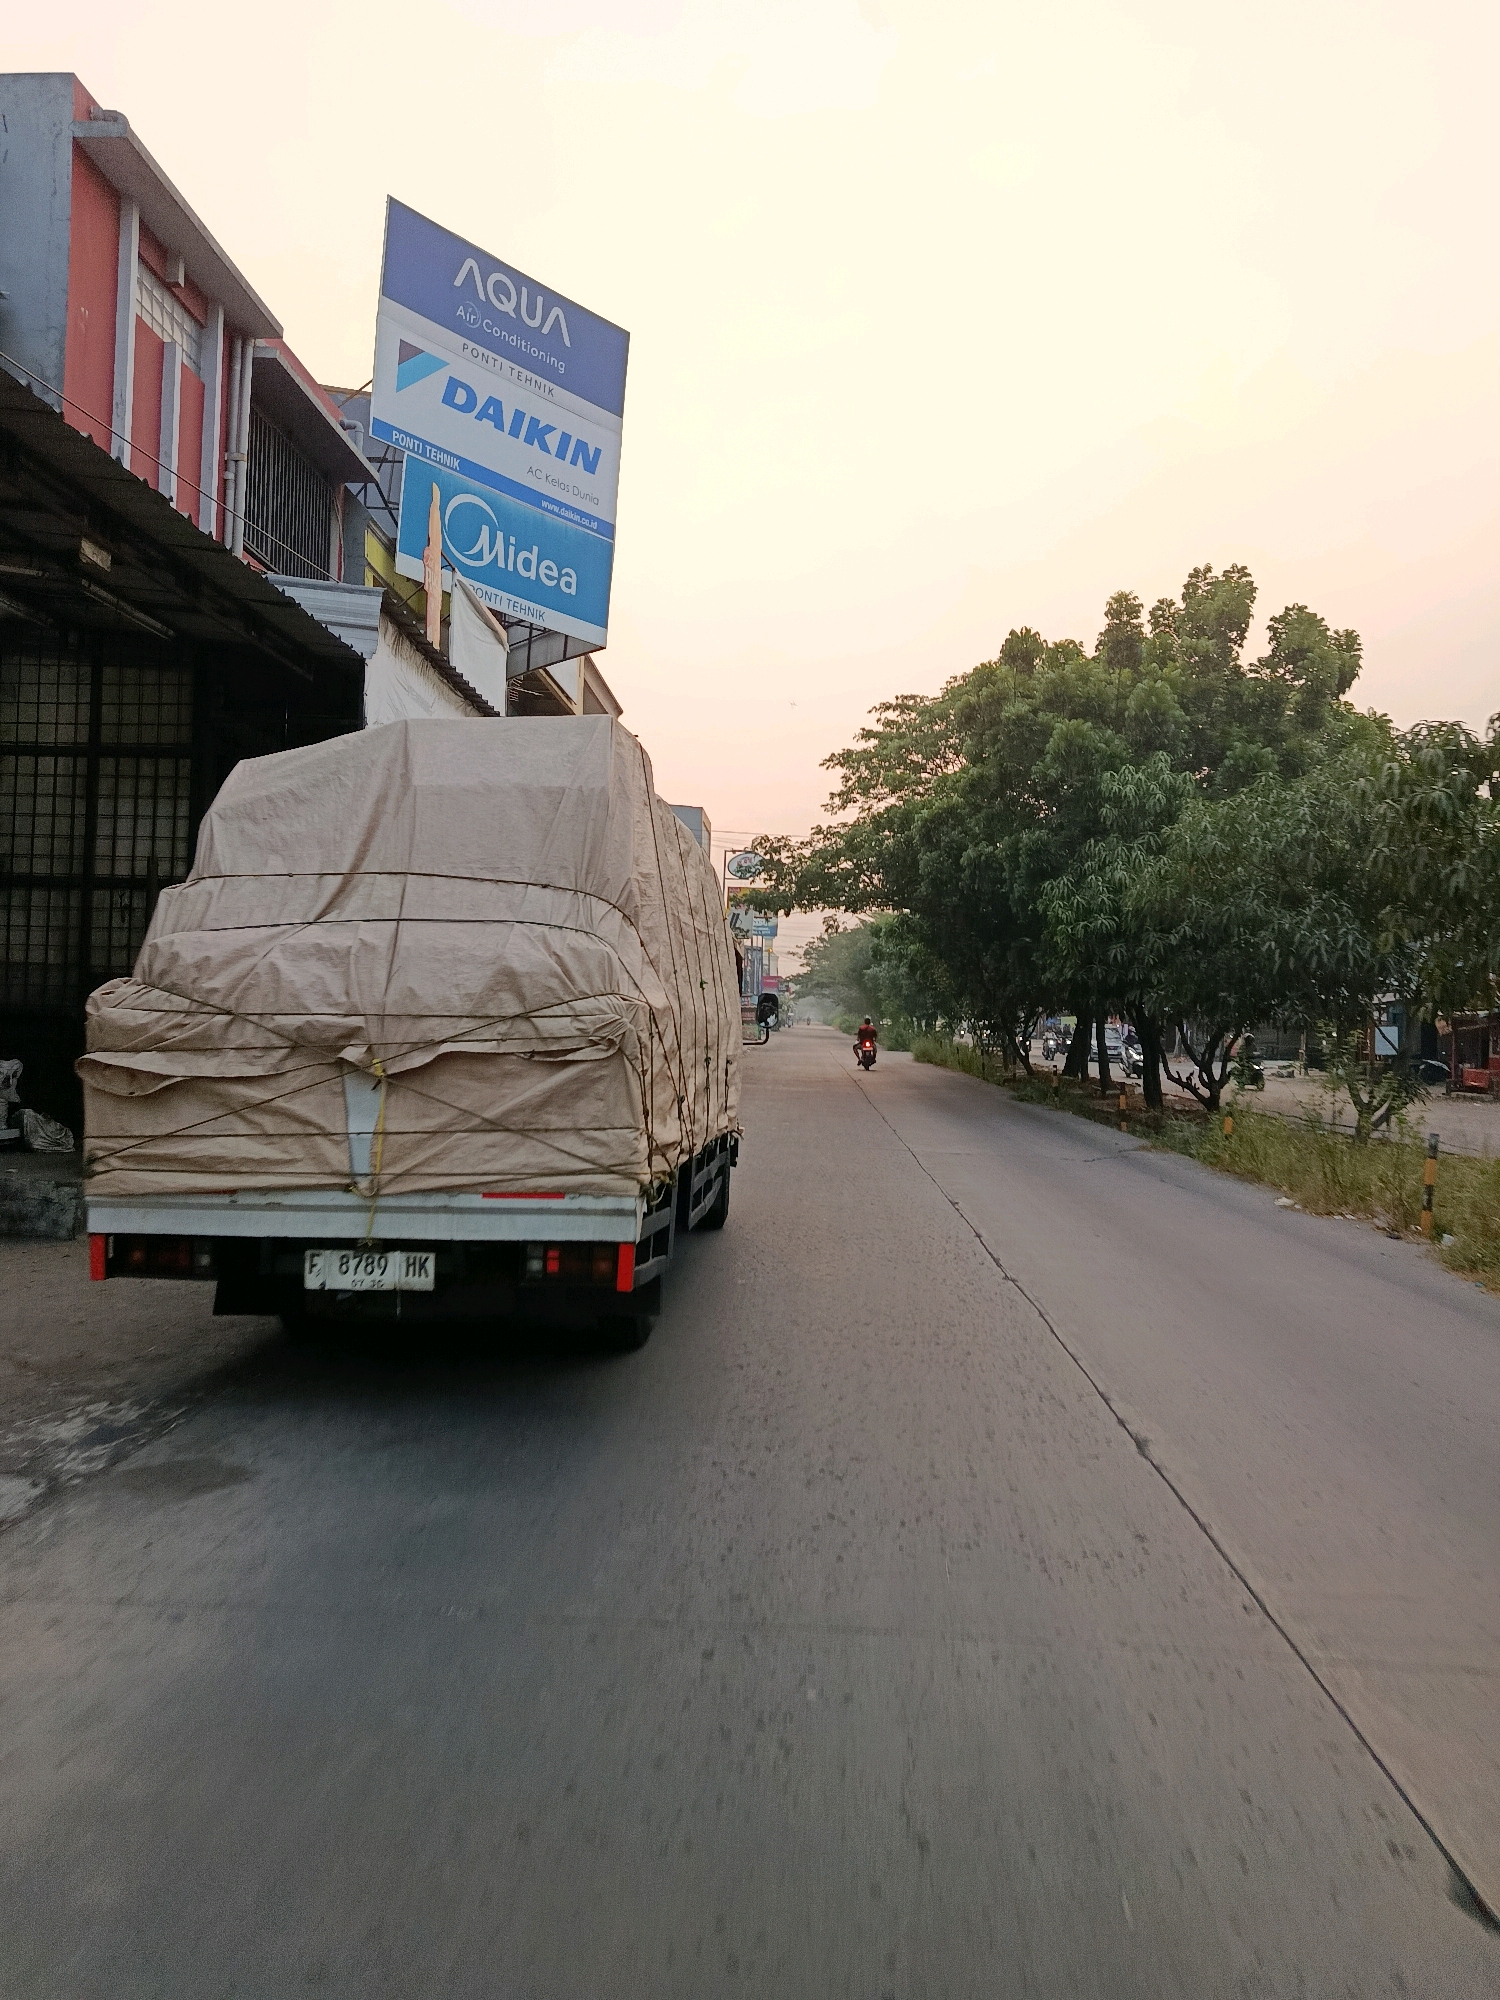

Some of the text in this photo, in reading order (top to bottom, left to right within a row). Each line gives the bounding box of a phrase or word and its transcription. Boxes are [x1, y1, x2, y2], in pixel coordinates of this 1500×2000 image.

[453, 257, 571, 348] AQUA
[456, 305, 566, 374] Air Conditioning
[462, 342, 555, 398] PONTI TEHNIK
[441, 375, 602, 476] DAIKIN
[392, 430, 460, 471] PONTI TEHNIK
[527, 466, 600, 506] AC Kelas Dunia
[541, 499, 598, 530] www.daikin.co.id
[463, 524, 578, 596] Midea
[506, 598, 546, 622] TEHNIK
[308, 1252, 430, 1279] F 8789 HK
